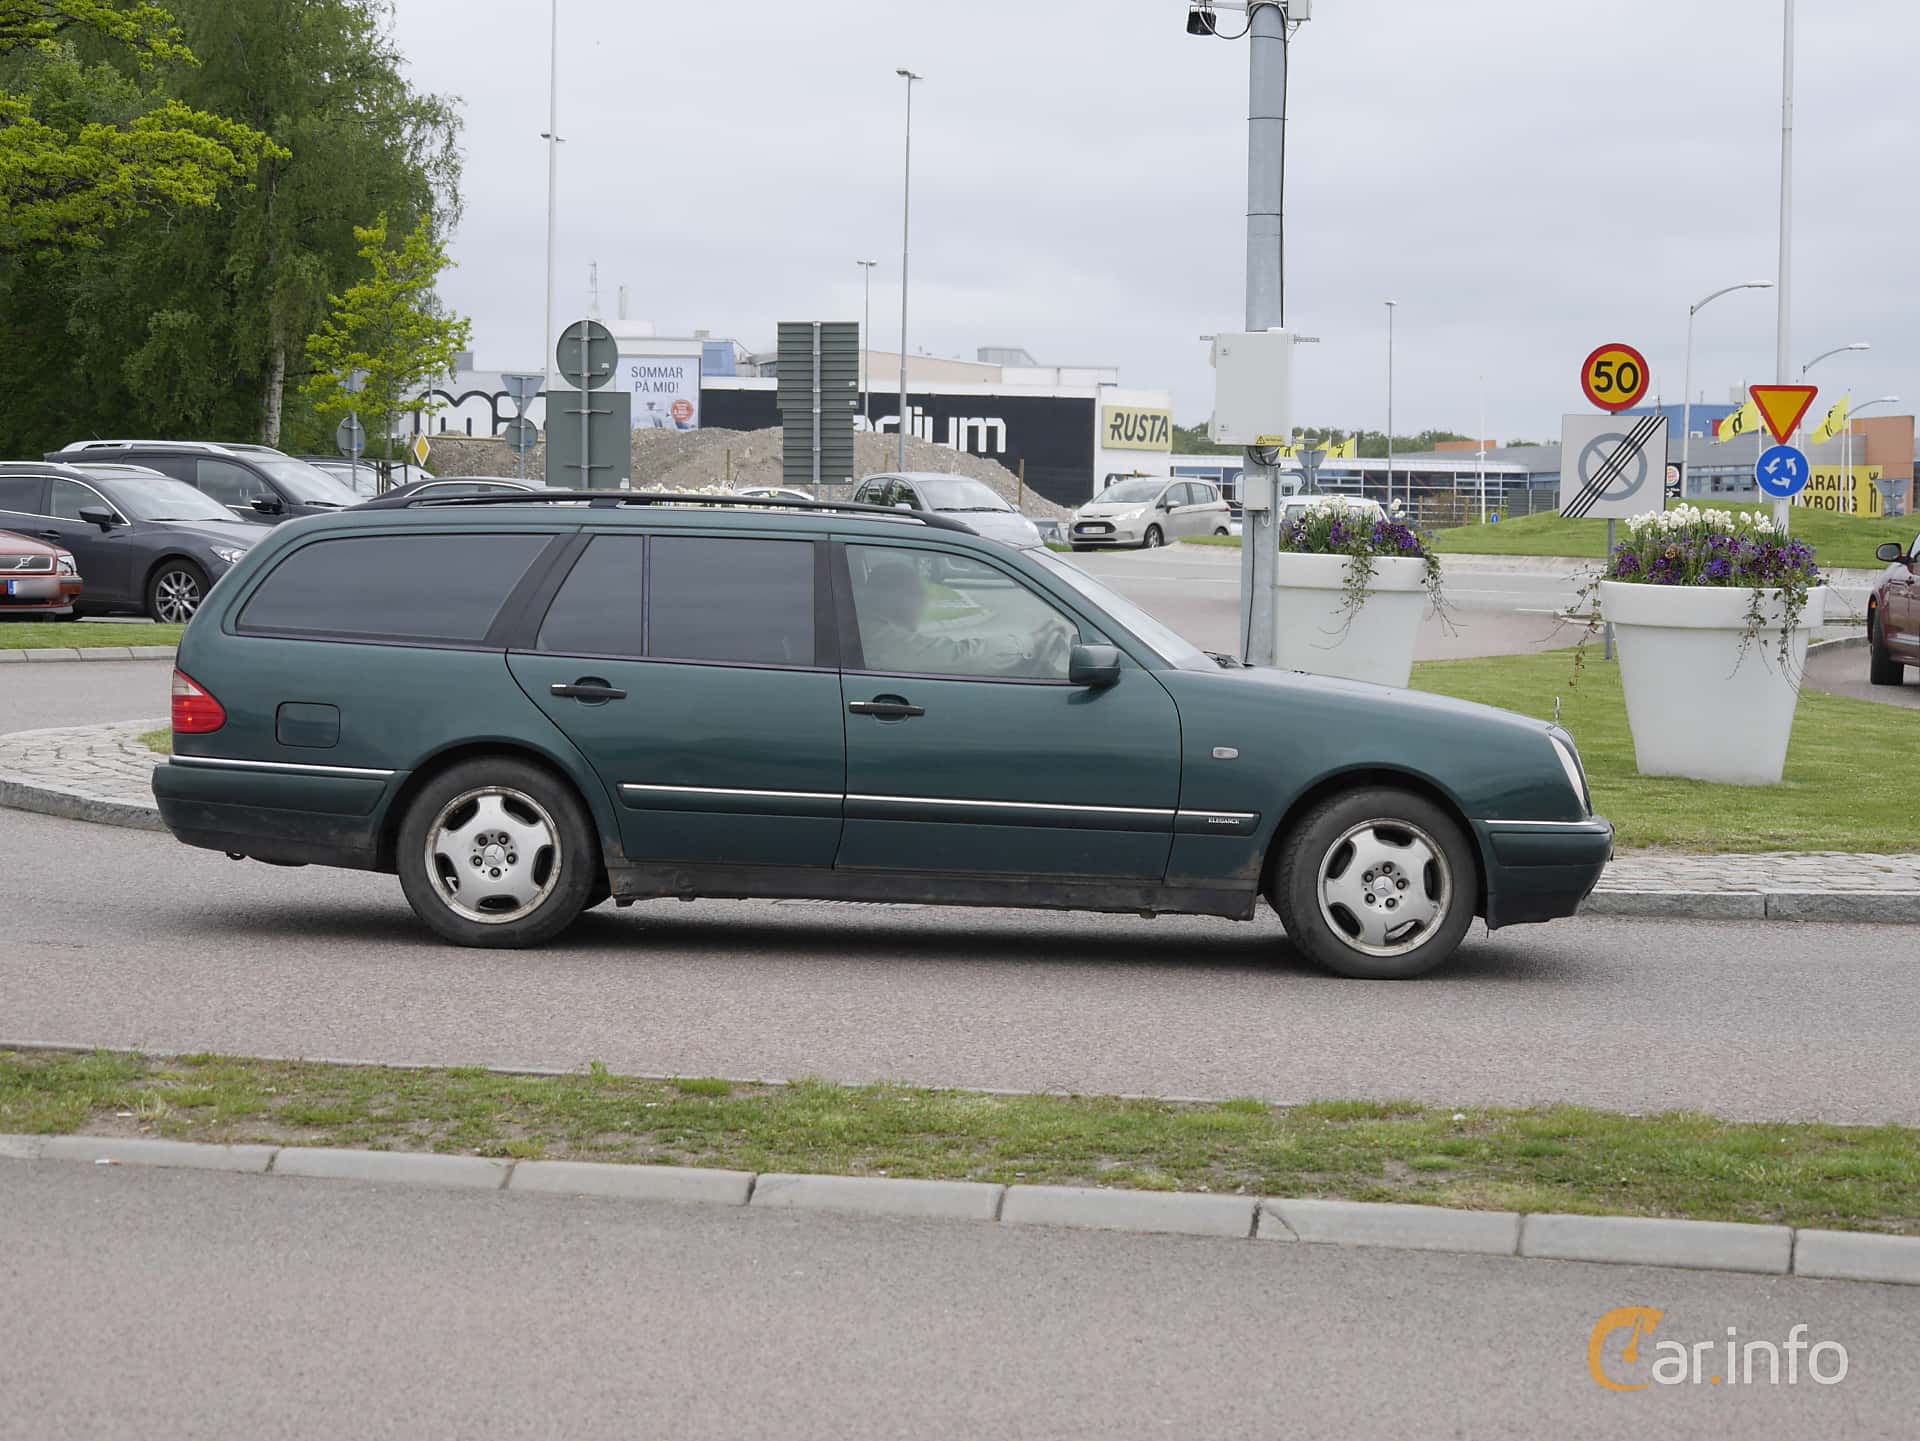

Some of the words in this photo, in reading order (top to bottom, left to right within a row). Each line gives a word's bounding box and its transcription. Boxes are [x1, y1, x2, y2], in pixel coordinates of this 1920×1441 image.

[631, 366, 684, 378] SOMMAR
[1594, 360, 1639, 394] 50
[653, 381, 679, 394] MIO!
[1109, 412, 1169, 443] RUSTA
[1803, 475, 1857, 491] ARALD
